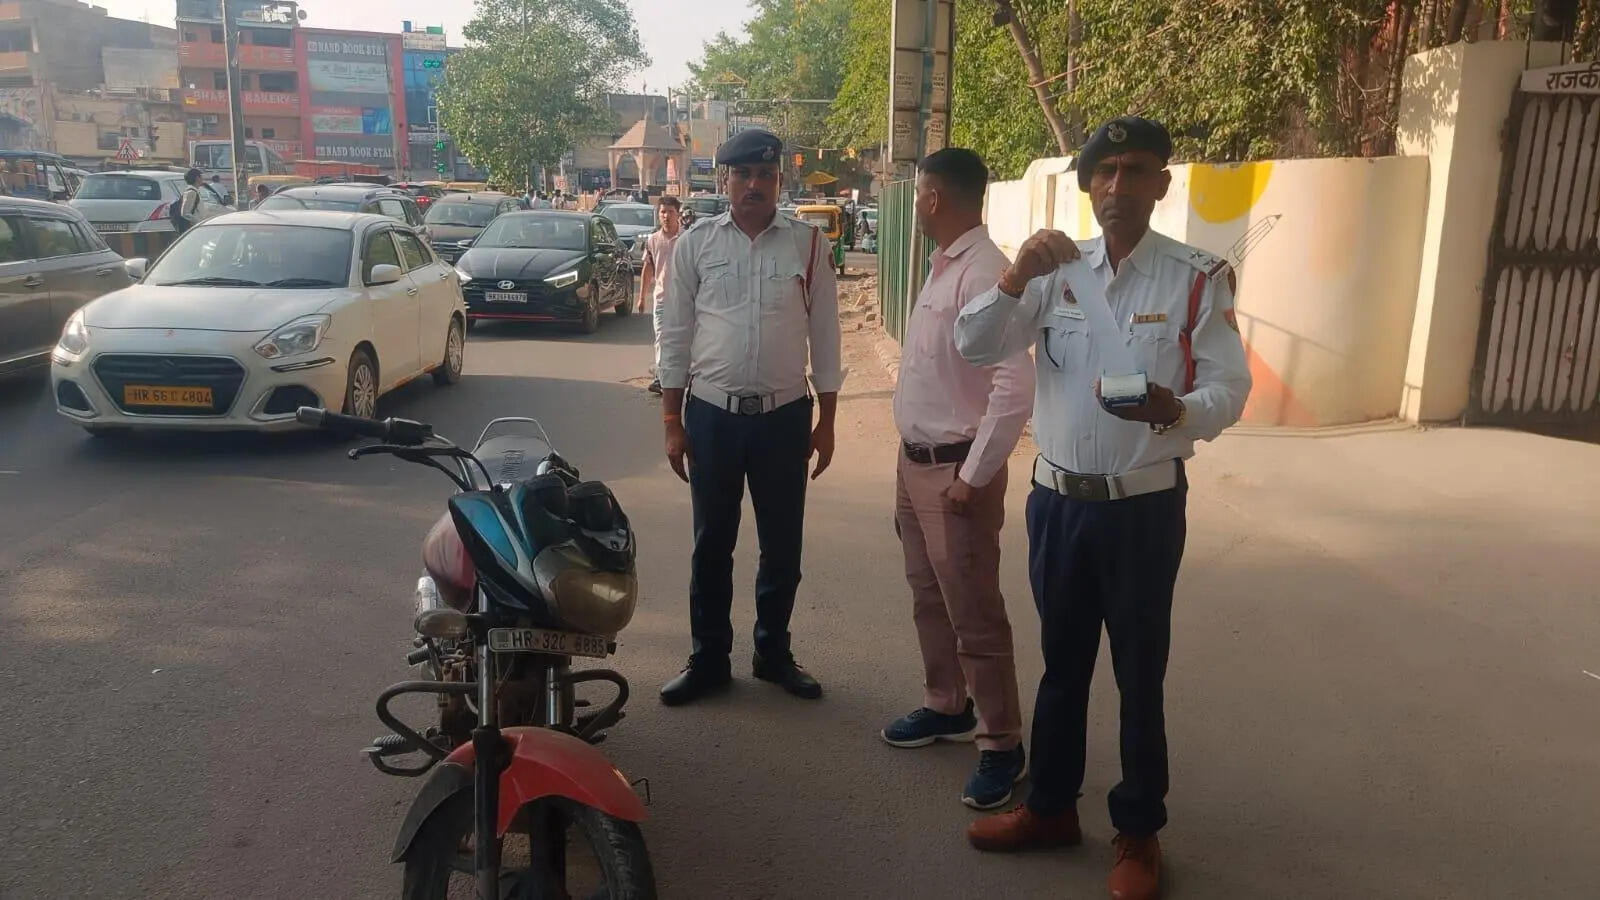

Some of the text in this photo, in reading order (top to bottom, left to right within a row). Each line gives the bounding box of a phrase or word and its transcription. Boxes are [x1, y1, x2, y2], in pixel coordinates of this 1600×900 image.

[342, 42, 365, 55] BOOK
[350, 146, 373, 158] BOOK
[511, 630, 532, 648] HR
